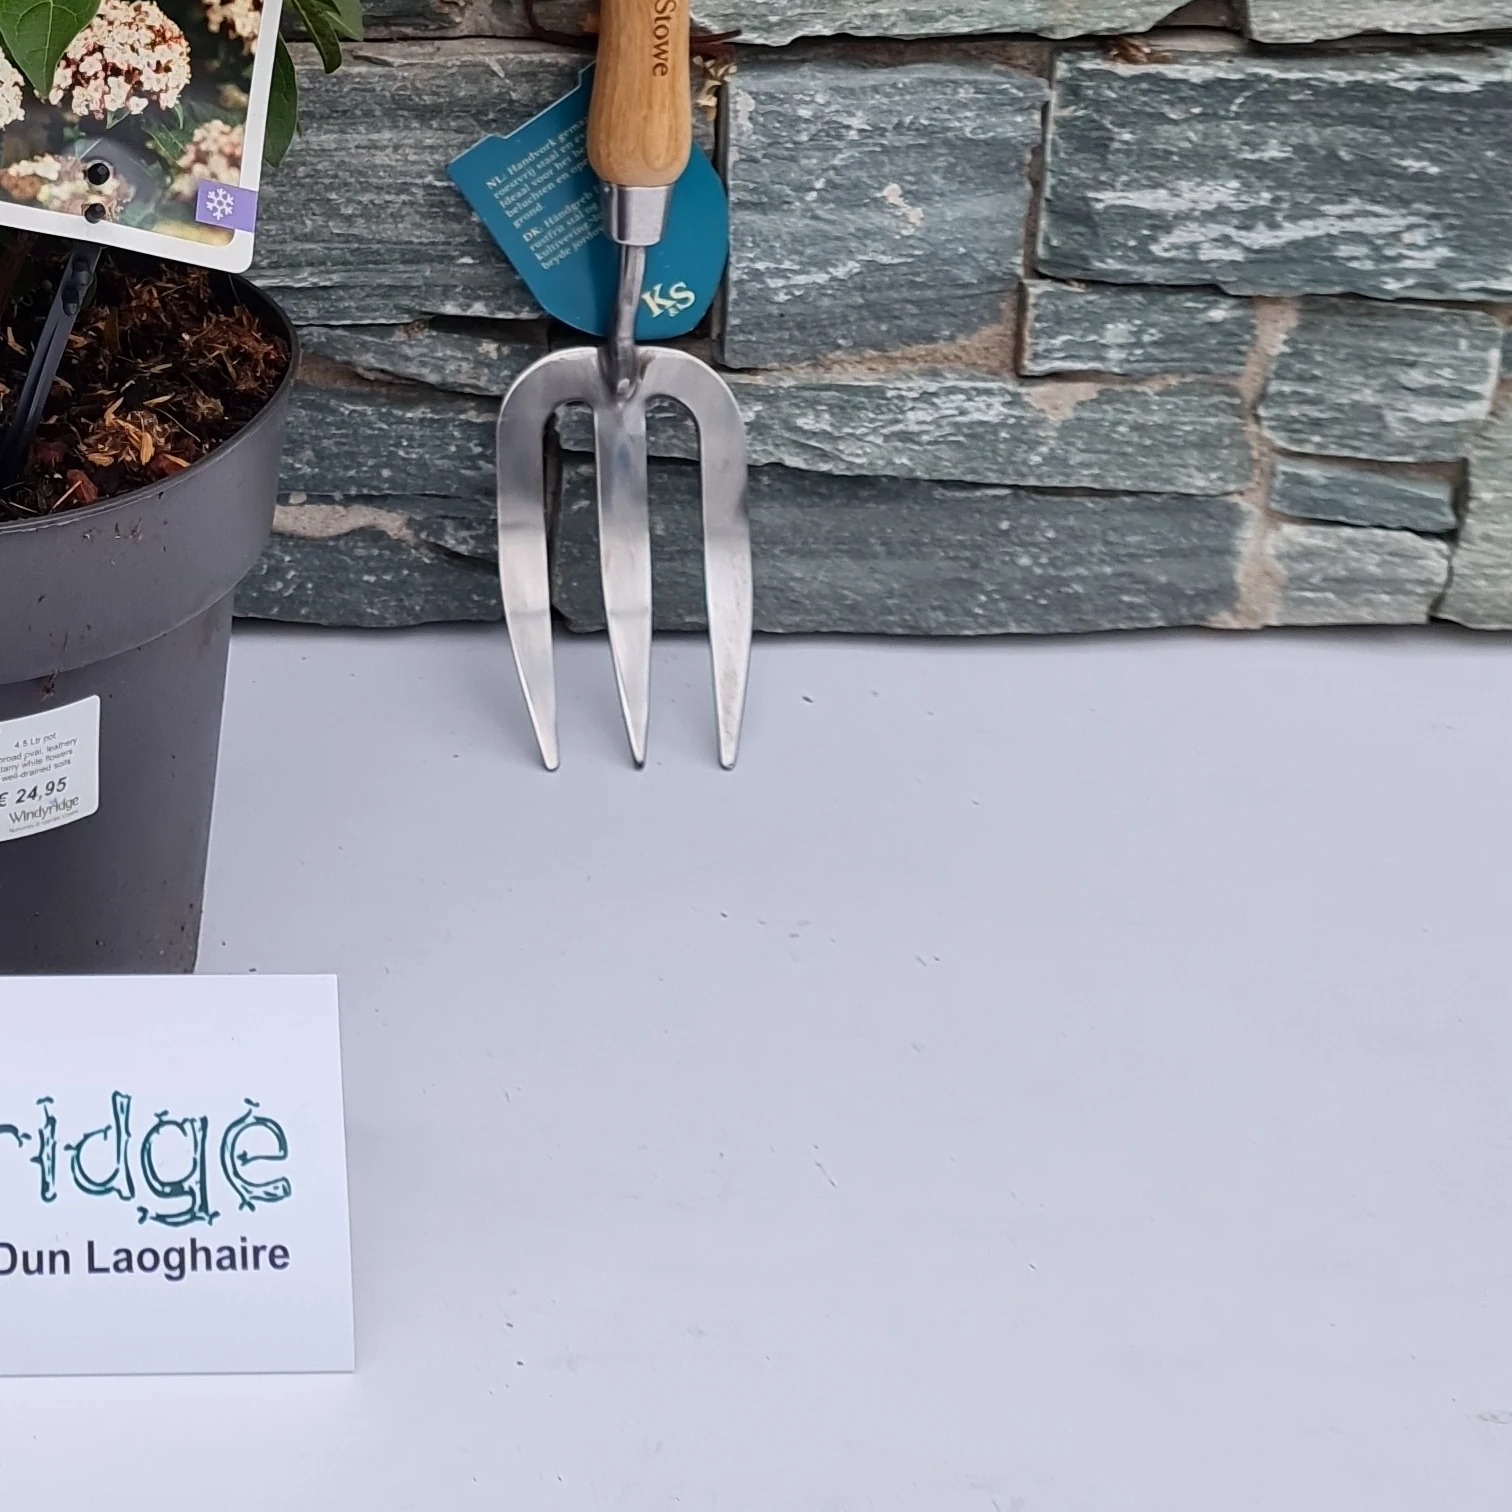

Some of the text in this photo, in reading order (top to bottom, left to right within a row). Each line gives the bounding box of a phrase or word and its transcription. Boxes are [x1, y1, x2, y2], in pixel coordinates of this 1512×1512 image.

[652, 0, 677, 77] Stowe
[15, 776, 67, 804] 24,95
[9, 796, 79, 824] Windyridge
[87, 1236, 290, 1282] Laoghaire
